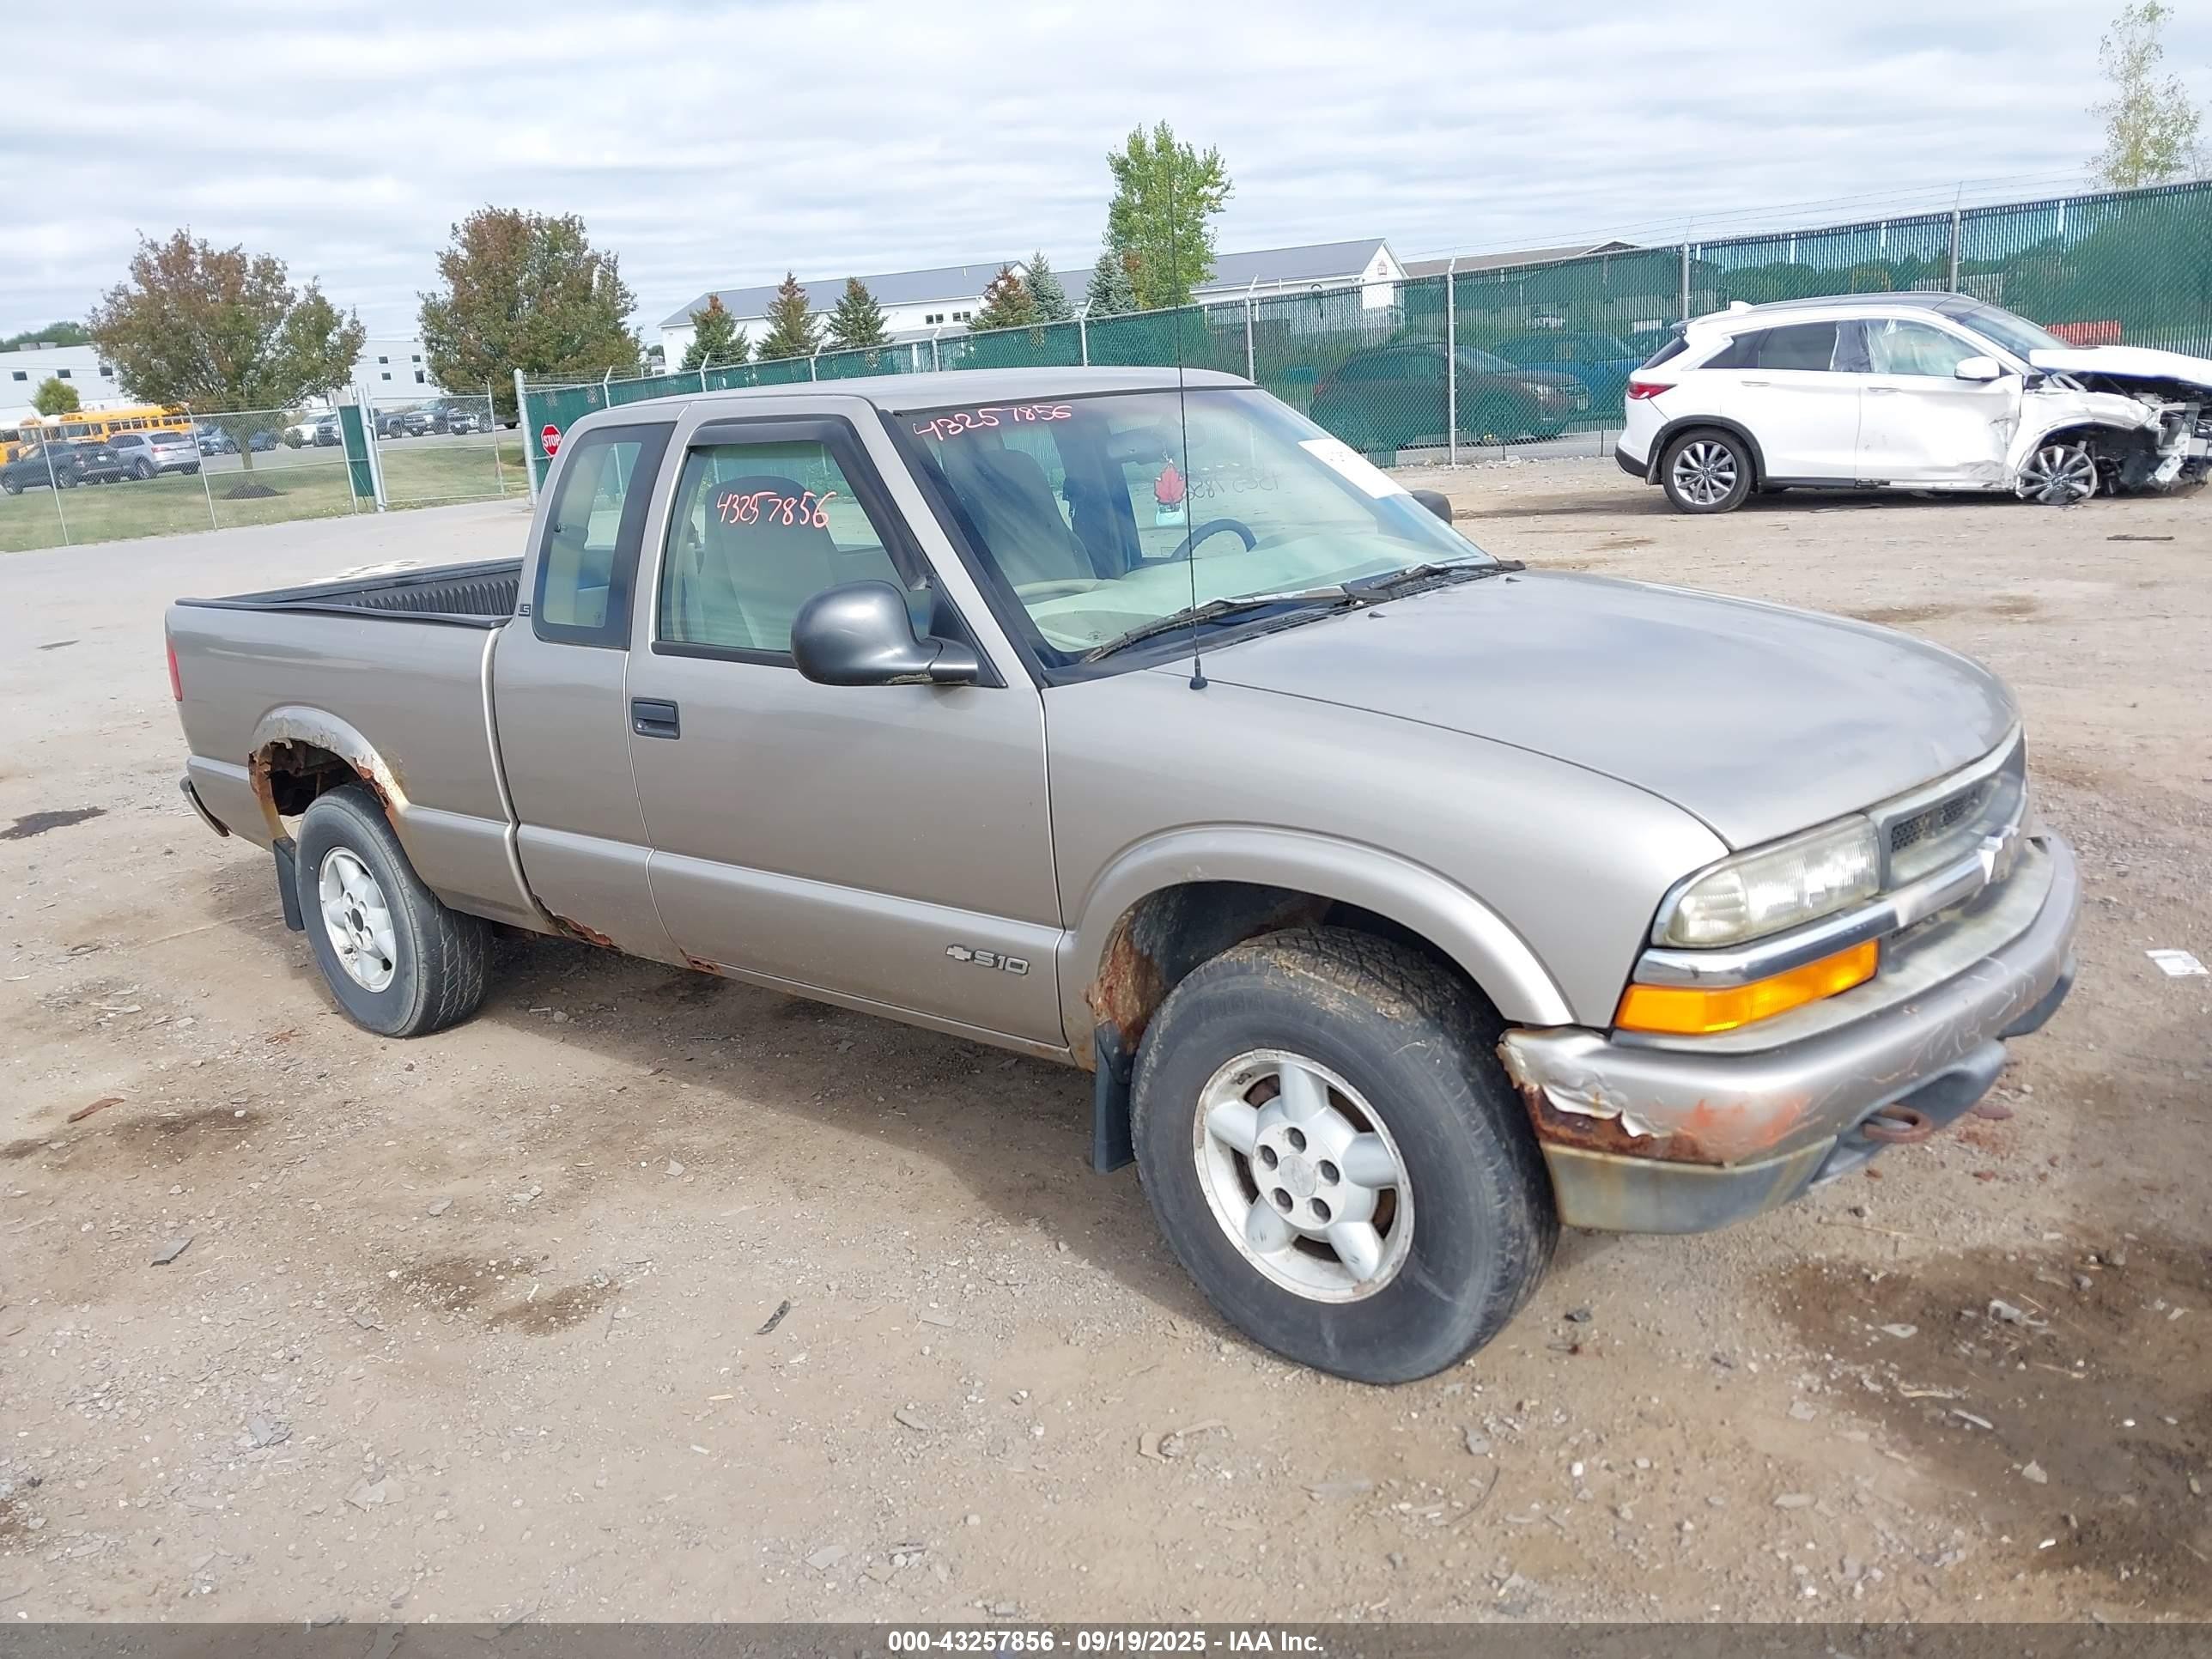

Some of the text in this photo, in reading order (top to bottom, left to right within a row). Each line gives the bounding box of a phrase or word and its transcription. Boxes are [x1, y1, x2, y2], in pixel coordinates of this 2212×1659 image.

[913, 405, 1073, 441] 43257856
[543, 434, 560, 447] STOP
[716, 491, 837, 528] 43257856
[973, 950, 1029, 975] S10
